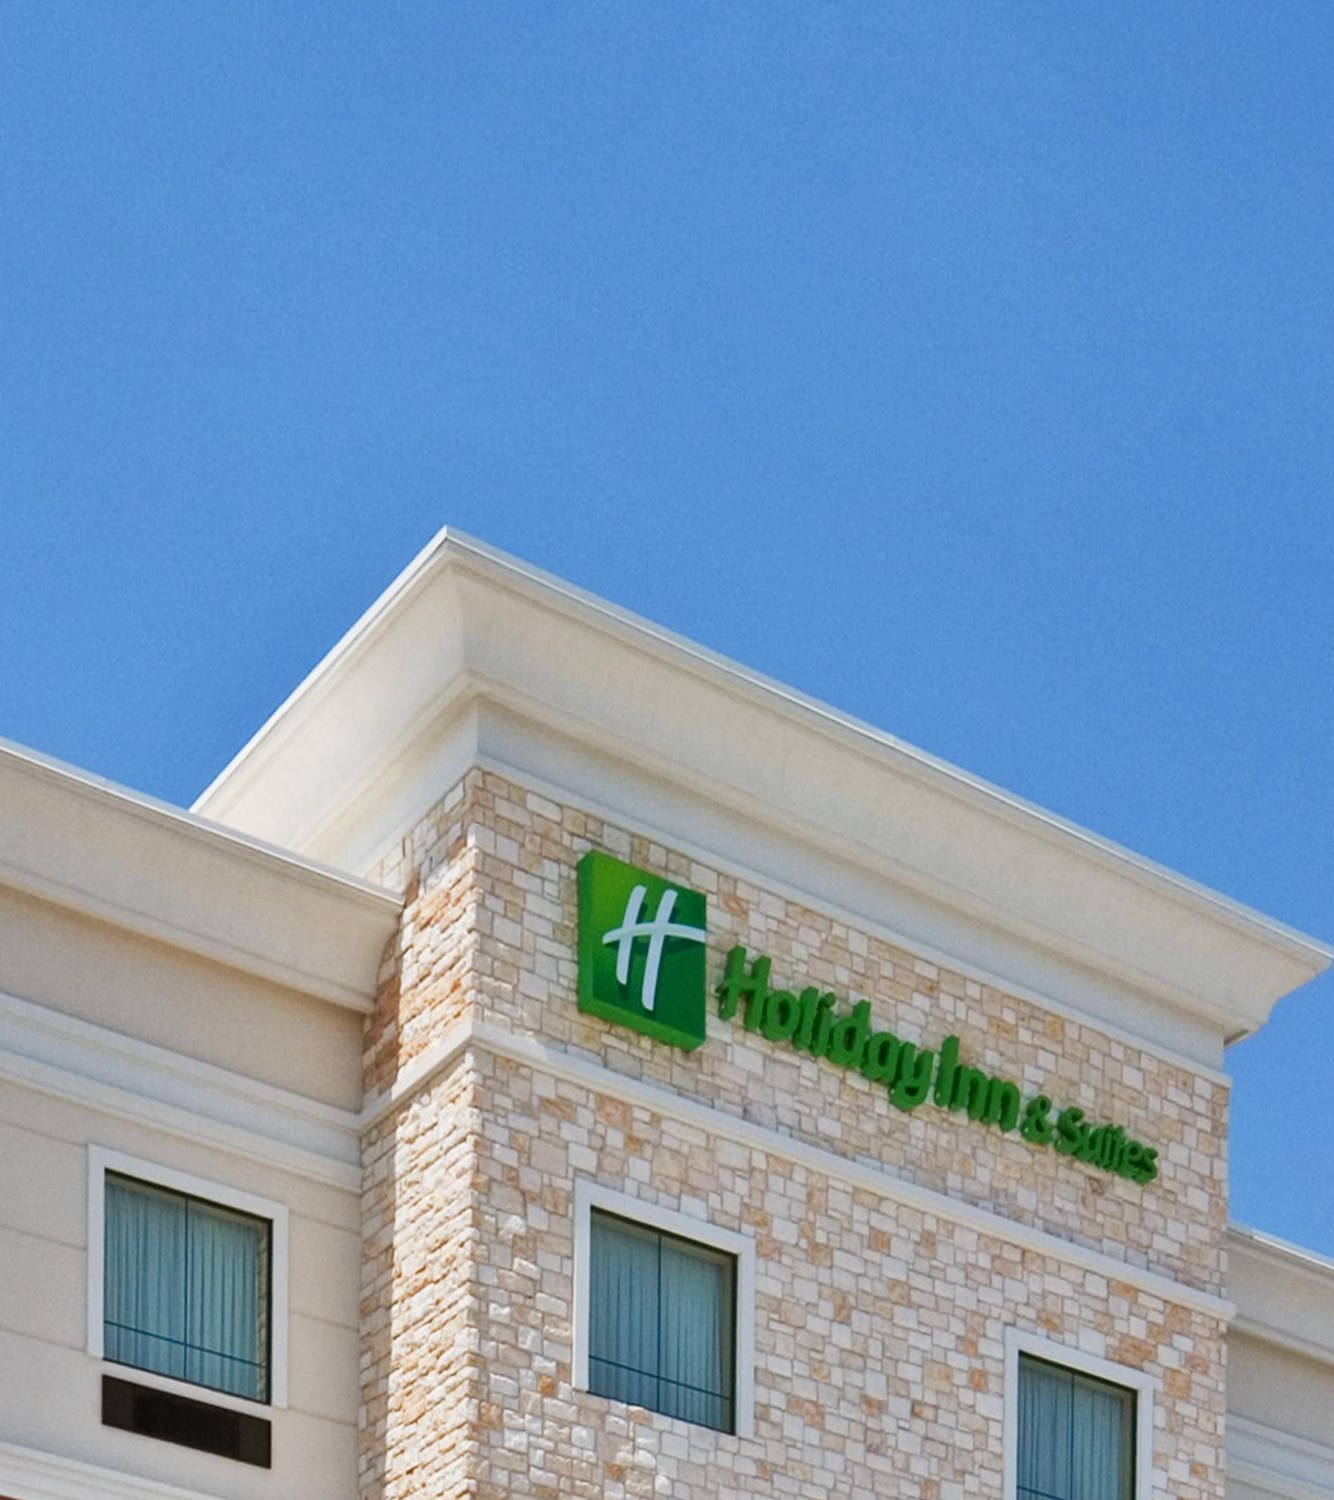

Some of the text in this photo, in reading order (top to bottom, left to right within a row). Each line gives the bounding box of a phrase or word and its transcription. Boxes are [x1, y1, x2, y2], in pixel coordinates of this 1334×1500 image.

[718, 944, 1160, 1186] Holiday Inn & Suites
